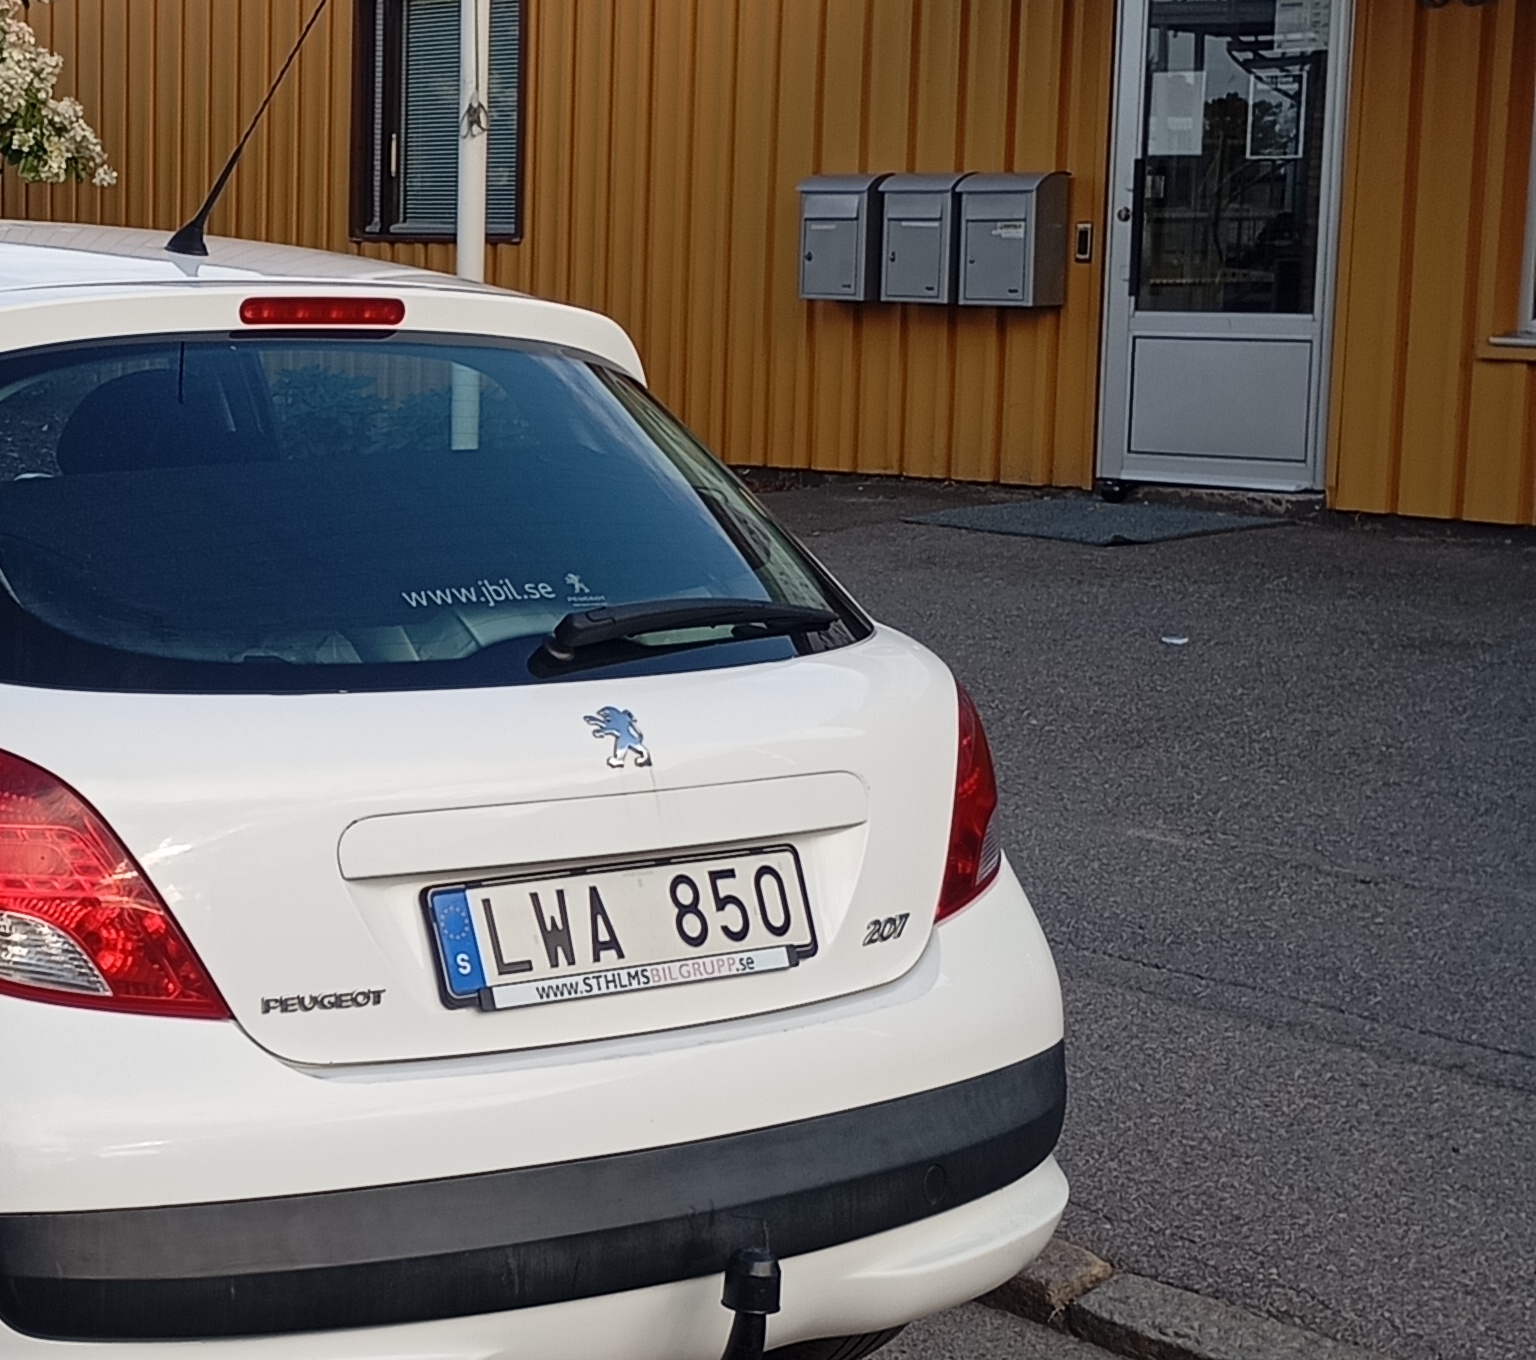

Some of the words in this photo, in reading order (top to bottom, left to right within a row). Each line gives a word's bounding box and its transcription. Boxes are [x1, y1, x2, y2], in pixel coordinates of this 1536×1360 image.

[402, 578, 556, 607] www.jbil.se
[482, 885, 625, 975] LWA
[669, 865, 791, 947] 850
[862, 913, 910, 946] 207
[457, 953, 472, 975] S
[261, 989, 386, 1014] PEUGEOT
